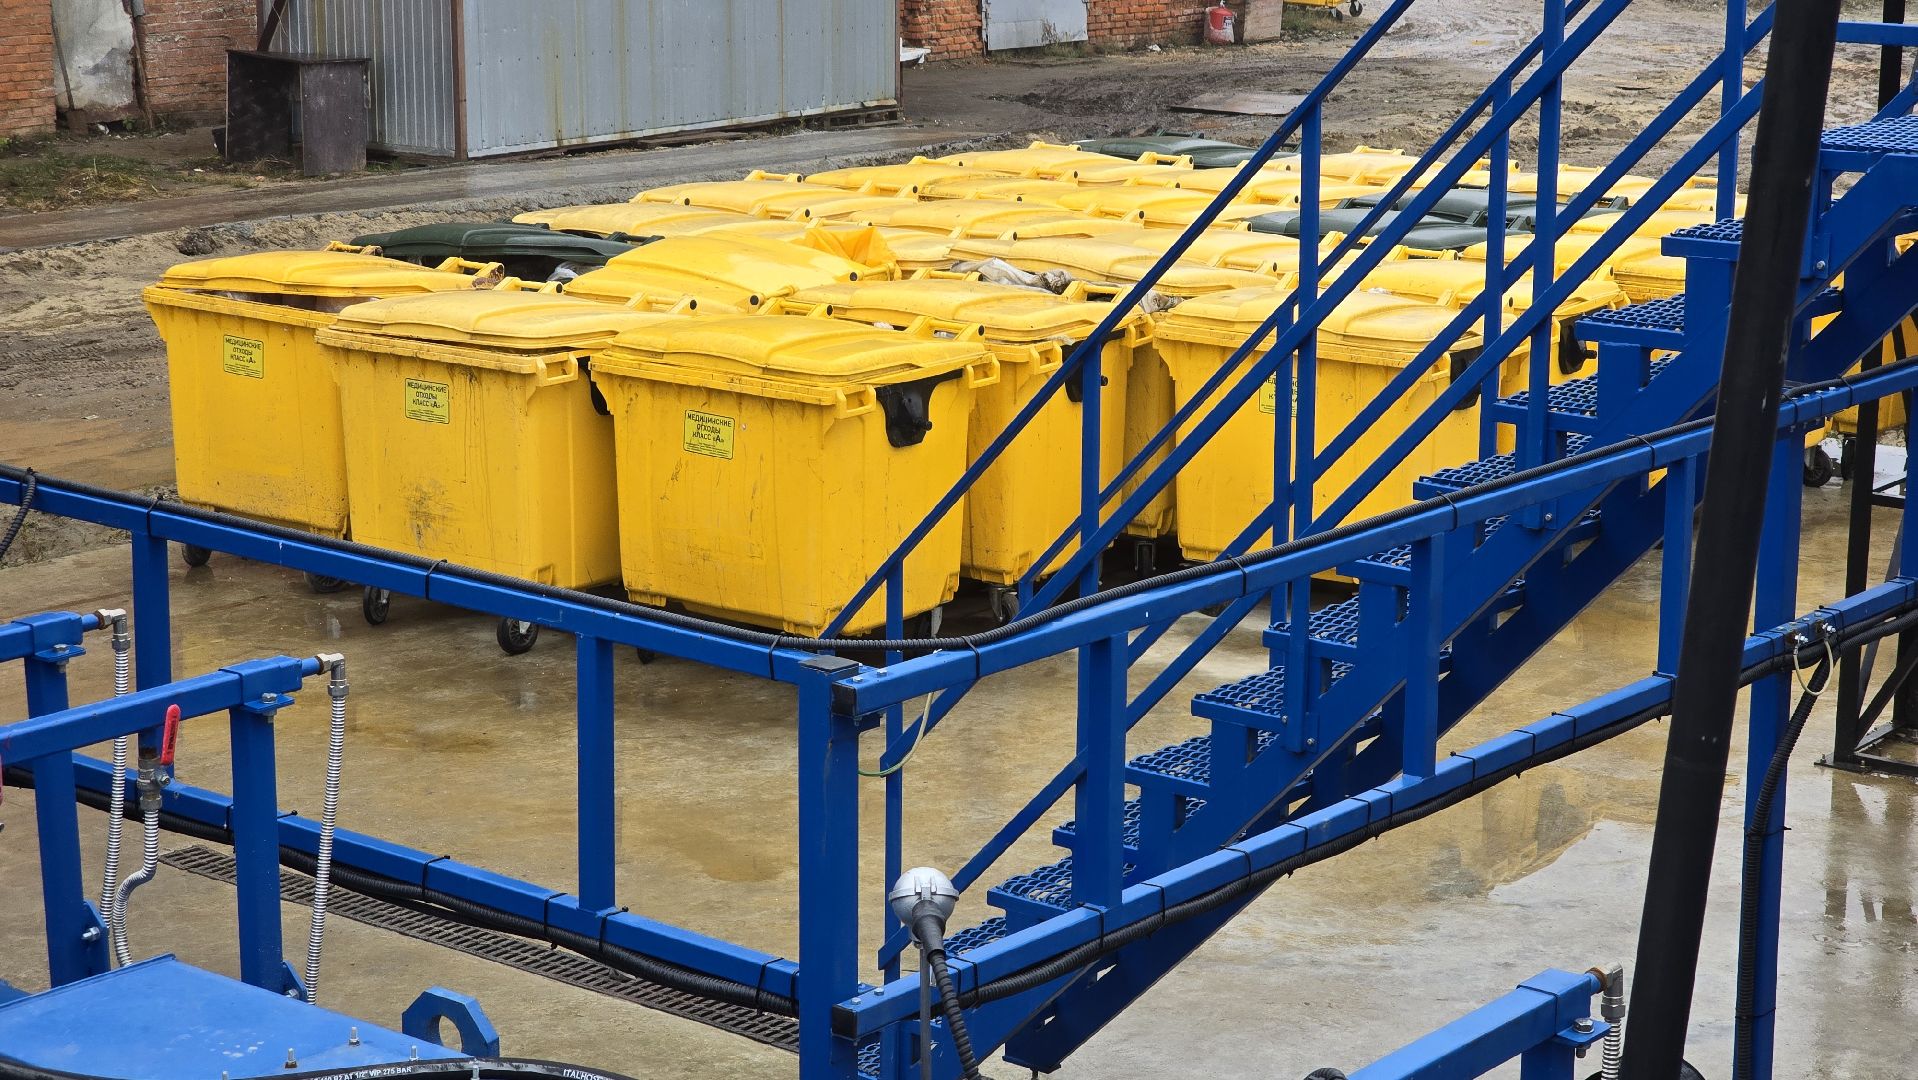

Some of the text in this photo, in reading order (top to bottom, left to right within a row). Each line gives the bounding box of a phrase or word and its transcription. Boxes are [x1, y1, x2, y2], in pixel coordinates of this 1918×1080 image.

[225, 338, 261, 350] МЕДИЦИНСКИЕ
[233, 347, 253, 356] ОТХОДЫ
[231, 354, 245, 362] КЛАСС
[407, 382, 447, 393] МЕДИЦИНСКИЕ
[415, 390, 437, 400] ОТХОДЫ
[687, 413, 732, 427] МЕДИЦИНСКИЕ
[696, 423, 721, 434] ОТХОДЫ
[692, 432, 711, 440] КЛАСС
[368, 1069, 381, 1077] WP
[382, 1067, 395, 1075] 275
[396, 1066, 412, 1074] BAR
